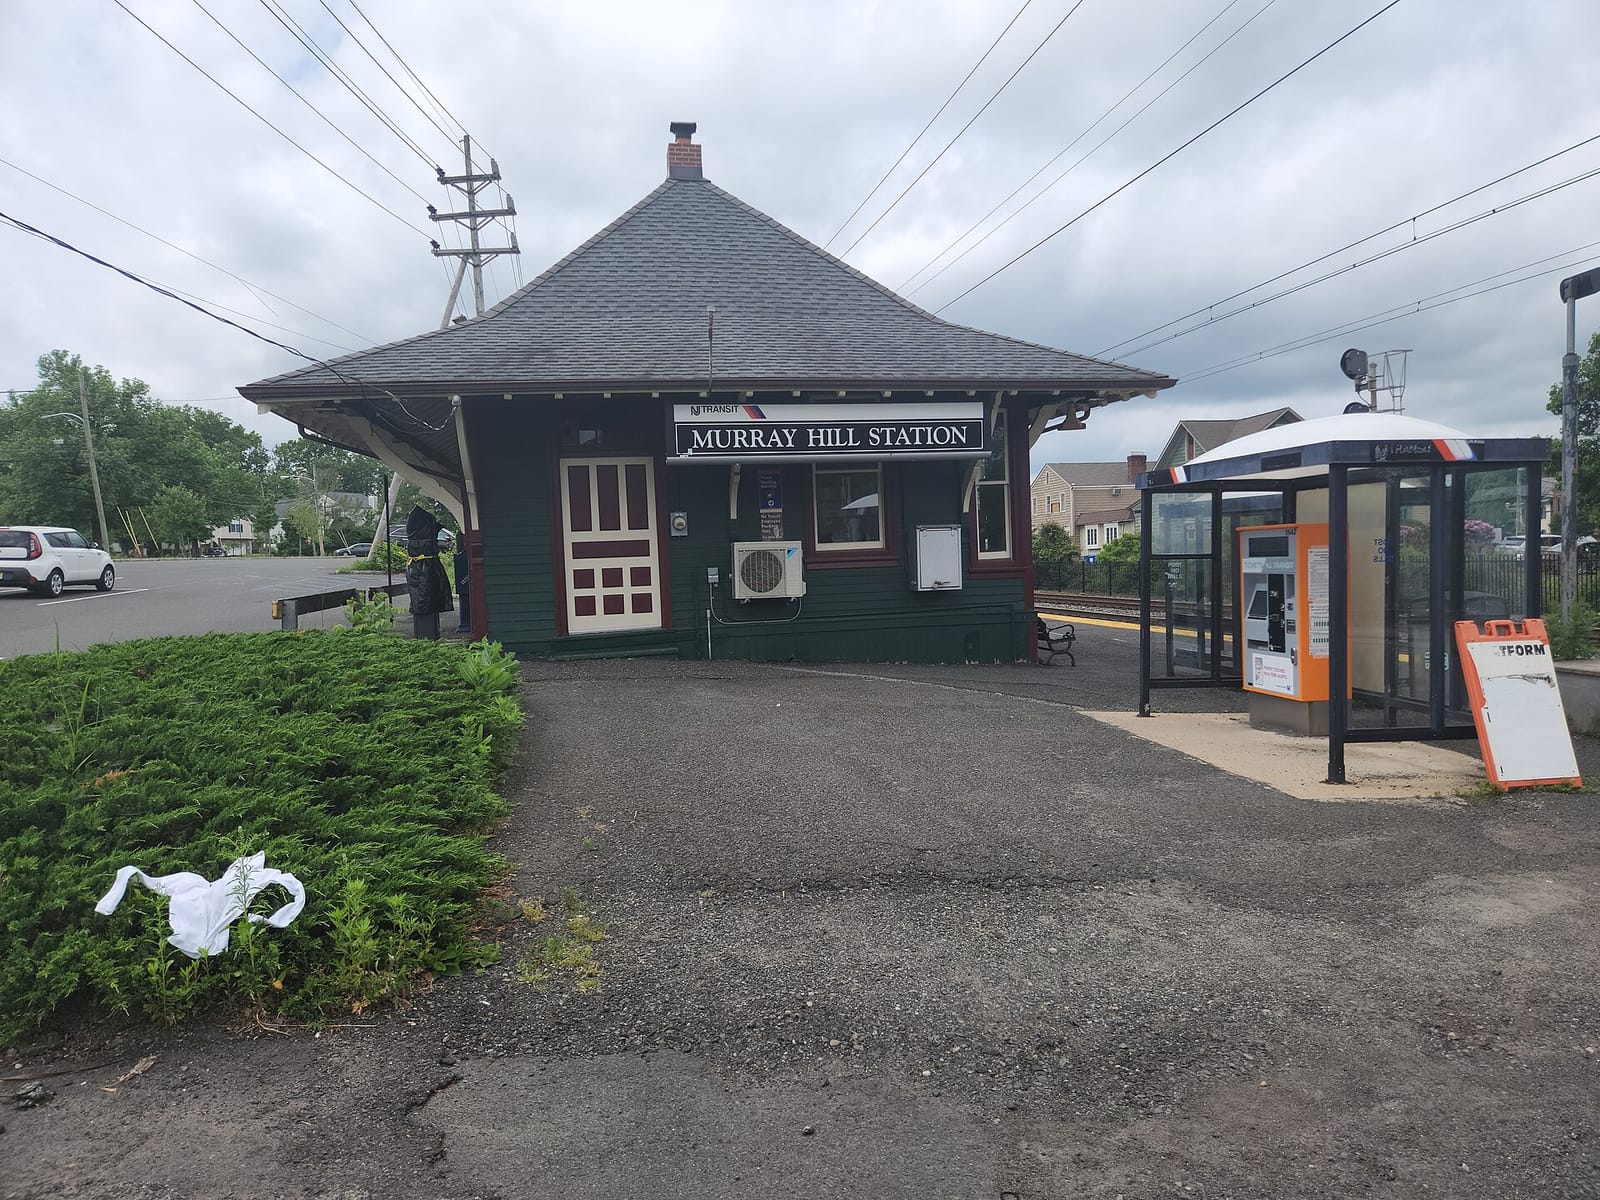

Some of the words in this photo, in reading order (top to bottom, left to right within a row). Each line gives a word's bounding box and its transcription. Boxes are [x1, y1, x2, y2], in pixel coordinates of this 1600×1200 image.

[690, 405, 701, 416] NJ
[701, 405, 740, 414] TRANSIT
[691, 428, 798, 449] MURRAY
[806, 427, 861, 447] HILL
[868, 426, 968, 446] STATION
